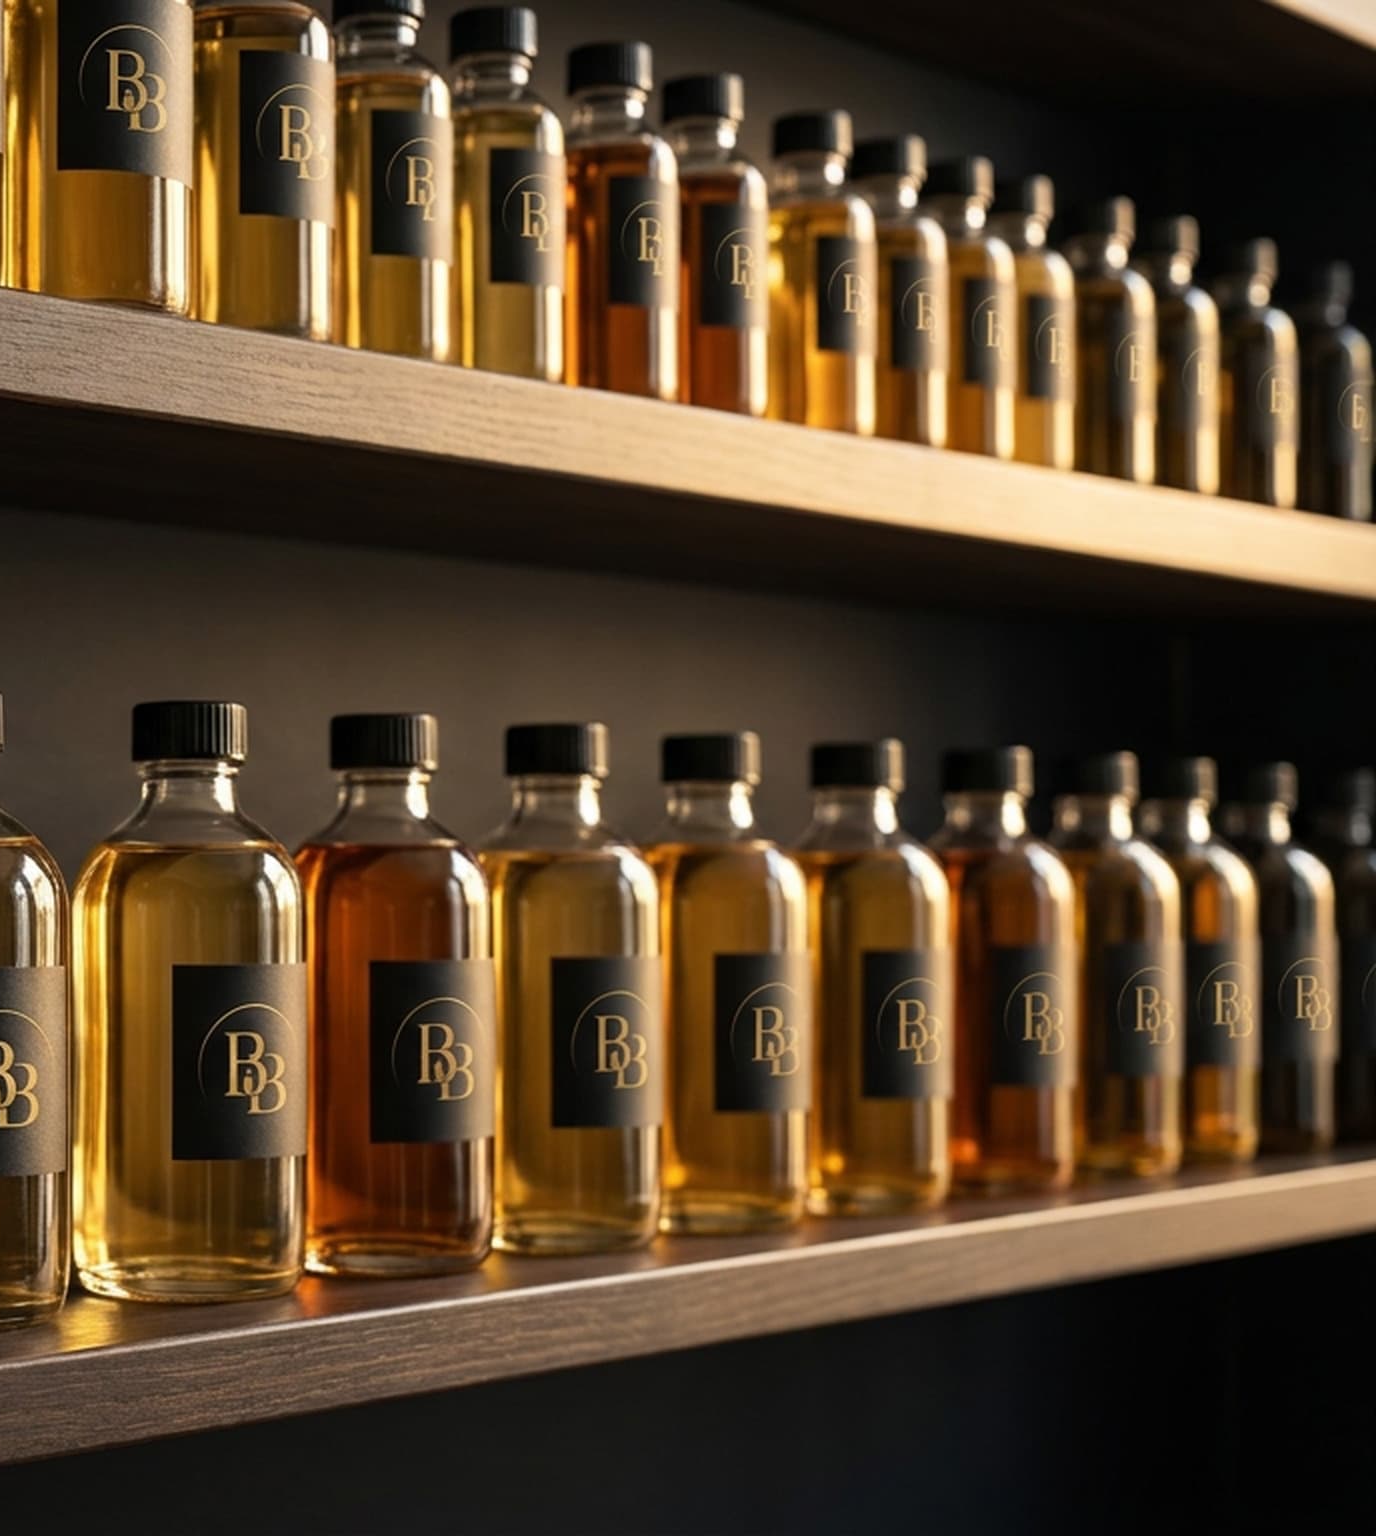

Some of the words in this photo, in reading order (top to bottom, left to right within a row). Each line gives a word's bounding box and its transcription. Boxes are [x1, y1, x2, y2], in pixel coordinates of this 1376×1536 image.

[105, 49, 168, 134] BB
[594, 1015, 648, 1089] BB
[752, 1006, 800, 1077] BB
[897, 999, 943, 1065] BB
[1022, 991, 1065, 1055] BB
[224, 1031, 287, 1115] BB
[417, 1023, 474, 1101] BB
